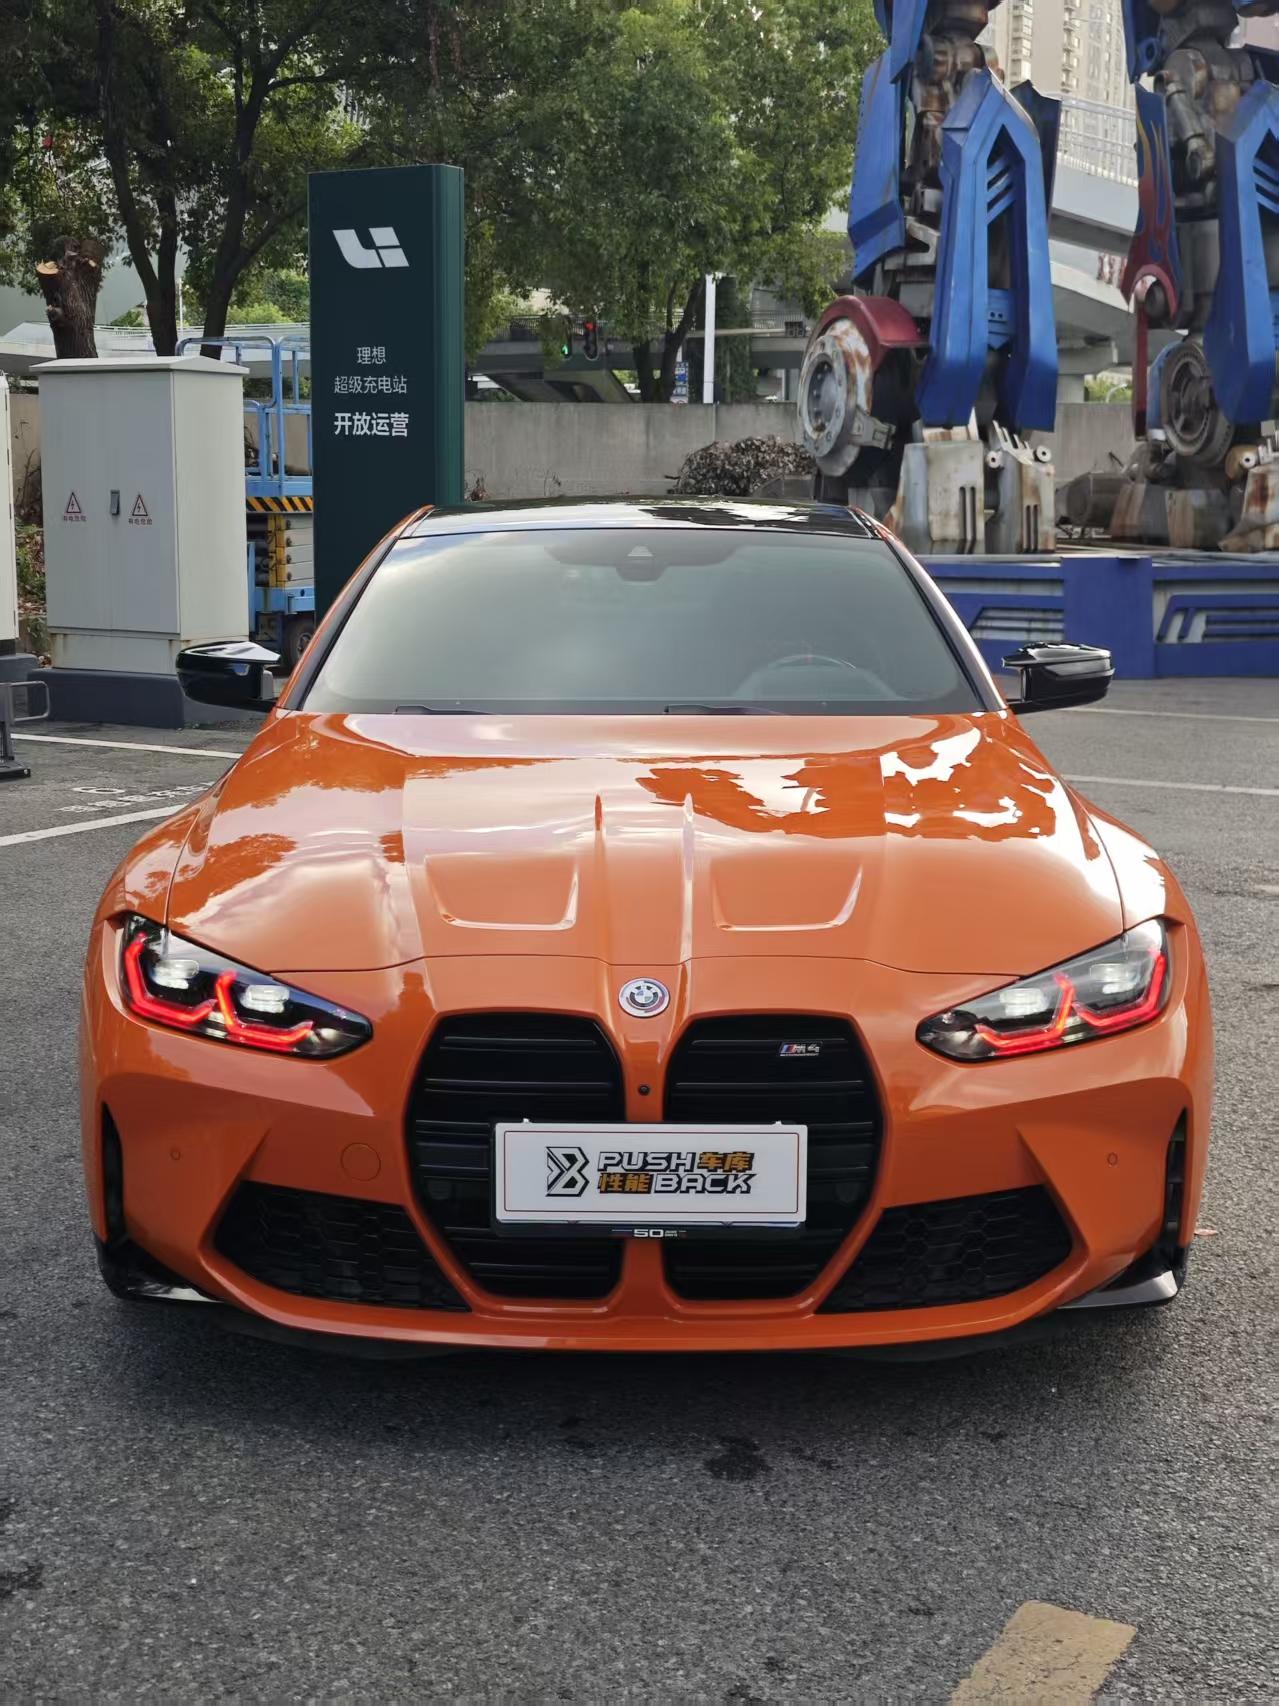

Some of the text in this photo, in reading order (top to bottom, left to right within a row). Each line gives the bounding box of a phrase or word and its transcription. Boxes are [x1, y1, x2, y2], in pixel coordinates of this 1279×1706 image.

[356, 346, 387, 365] 理想
[333, 375, 408, 394] 超级充电站
[333, 412, 410, 437] 开放运营
[597, 1151, 755, 1173] PUSH 车库
[597, 1173, 757, 1194] 性能 BACK
[633, 1228, 664, 1238] 50
